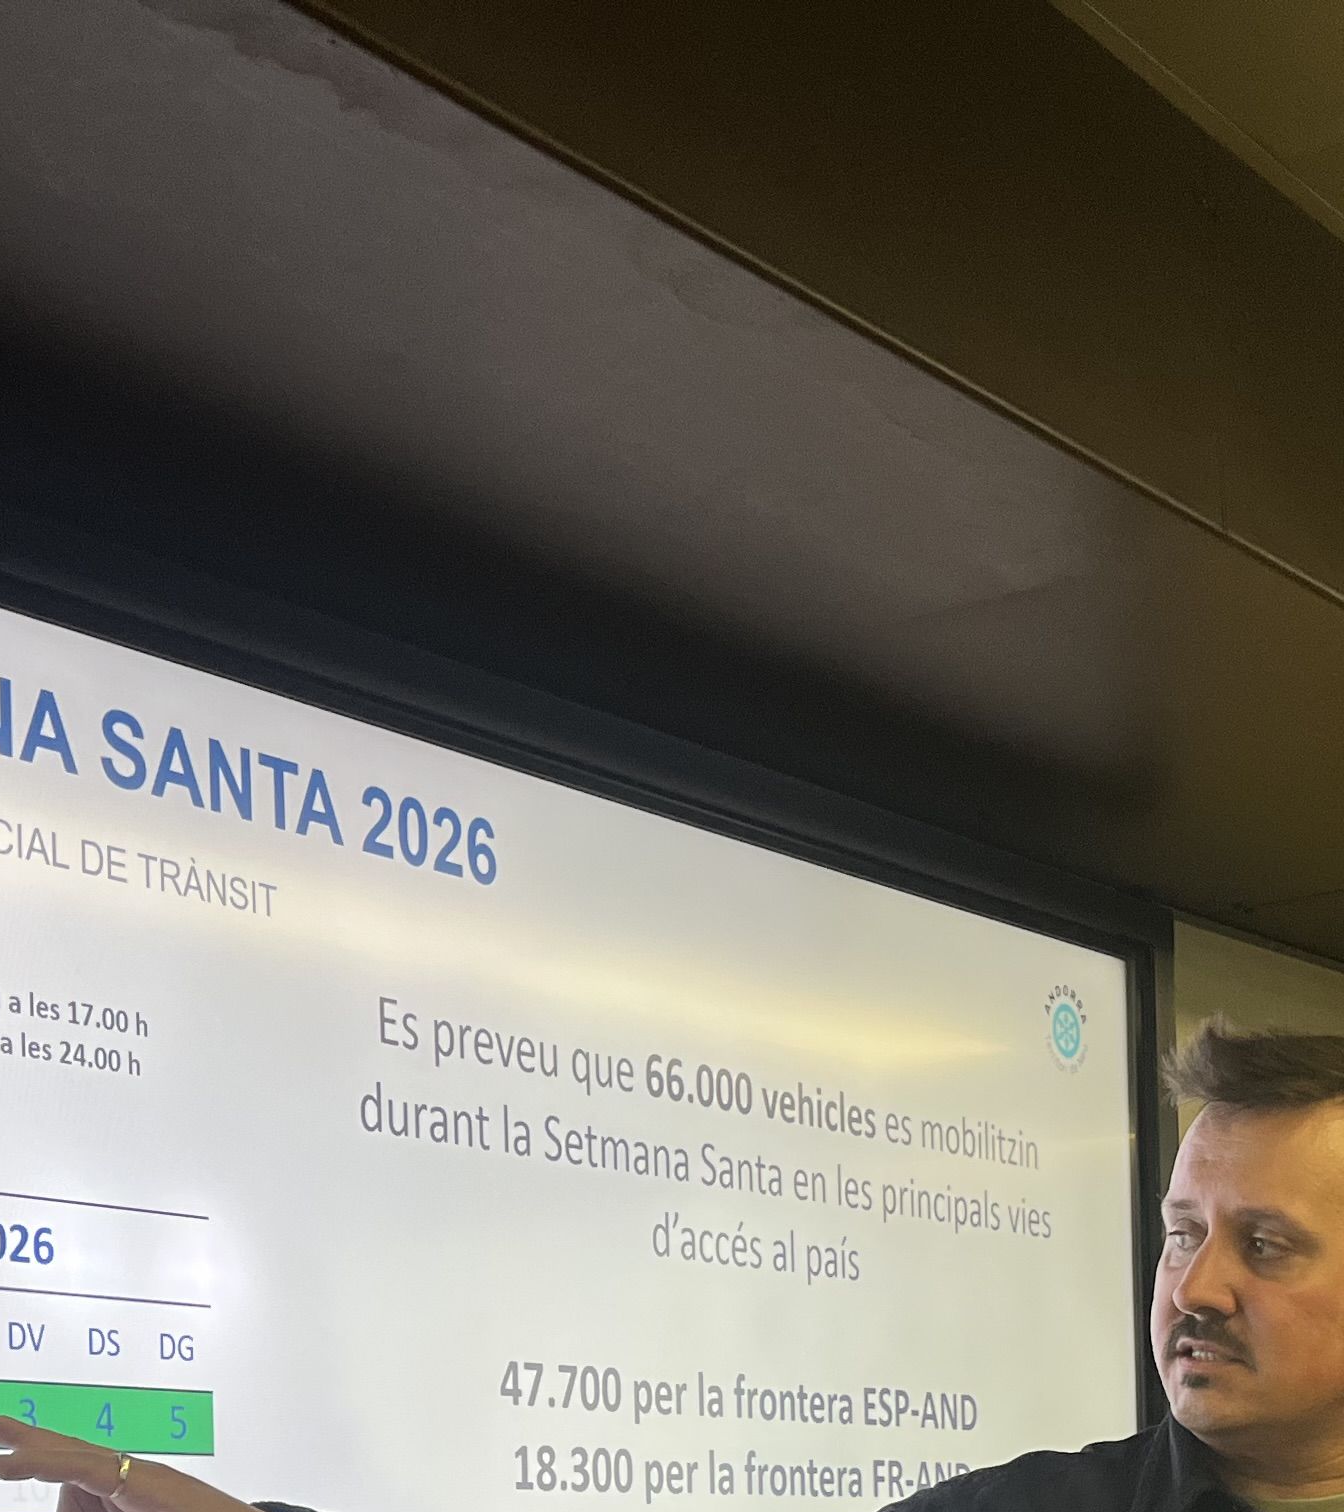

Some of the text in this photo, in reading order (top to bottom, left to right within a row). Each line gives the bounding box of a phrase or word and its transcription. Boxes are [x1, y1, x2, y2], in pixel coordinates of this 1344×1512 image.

[101, 710, 344, 846] SANTA
[362, 786, 496, 885] 2026
[81, 840, 127, 883] DE
[137, 853, 277, 916] TRÀNSIT
[9, 996, 21, 1013] a
[30, 992, 60, 1020] les
[68, 1001, 128, 1032] 17.00
[136, 1012, 147, 1037] h
[1, 1037, 12, 1054] a
[21, 1032, 51, 1060] les
[60, 1041, 120, 1072] 24.00
[129, 1051, 140, 1076] h
[380, 997, 1038, 1169] Es preveu que 66.000 vehicles es mobilitzin
[361, 1082, 1051, 1238] durant la Setmana Santa en les principals vies
[653, 1212, 859, 1285] d'accés al país
[9, 1322, 44, 1351] DV
[89, 1328, 120, 1356] DS
[160, 1333, 193, 1361] DG
[19, 1398, 37, 1428] 3
[95, 1403, 115, 1437] 4
[170, 1405, 186, 1440] 5
[501, 1361, 977, 1430] 47.700 per la frontera ESP-AND
[515, 1445, 632, 1493] 18.300
[645, 1461, 698, 1504] per
[709, 1450, 734, 1495] la
[745, 1450, 862, 1497] frontera
